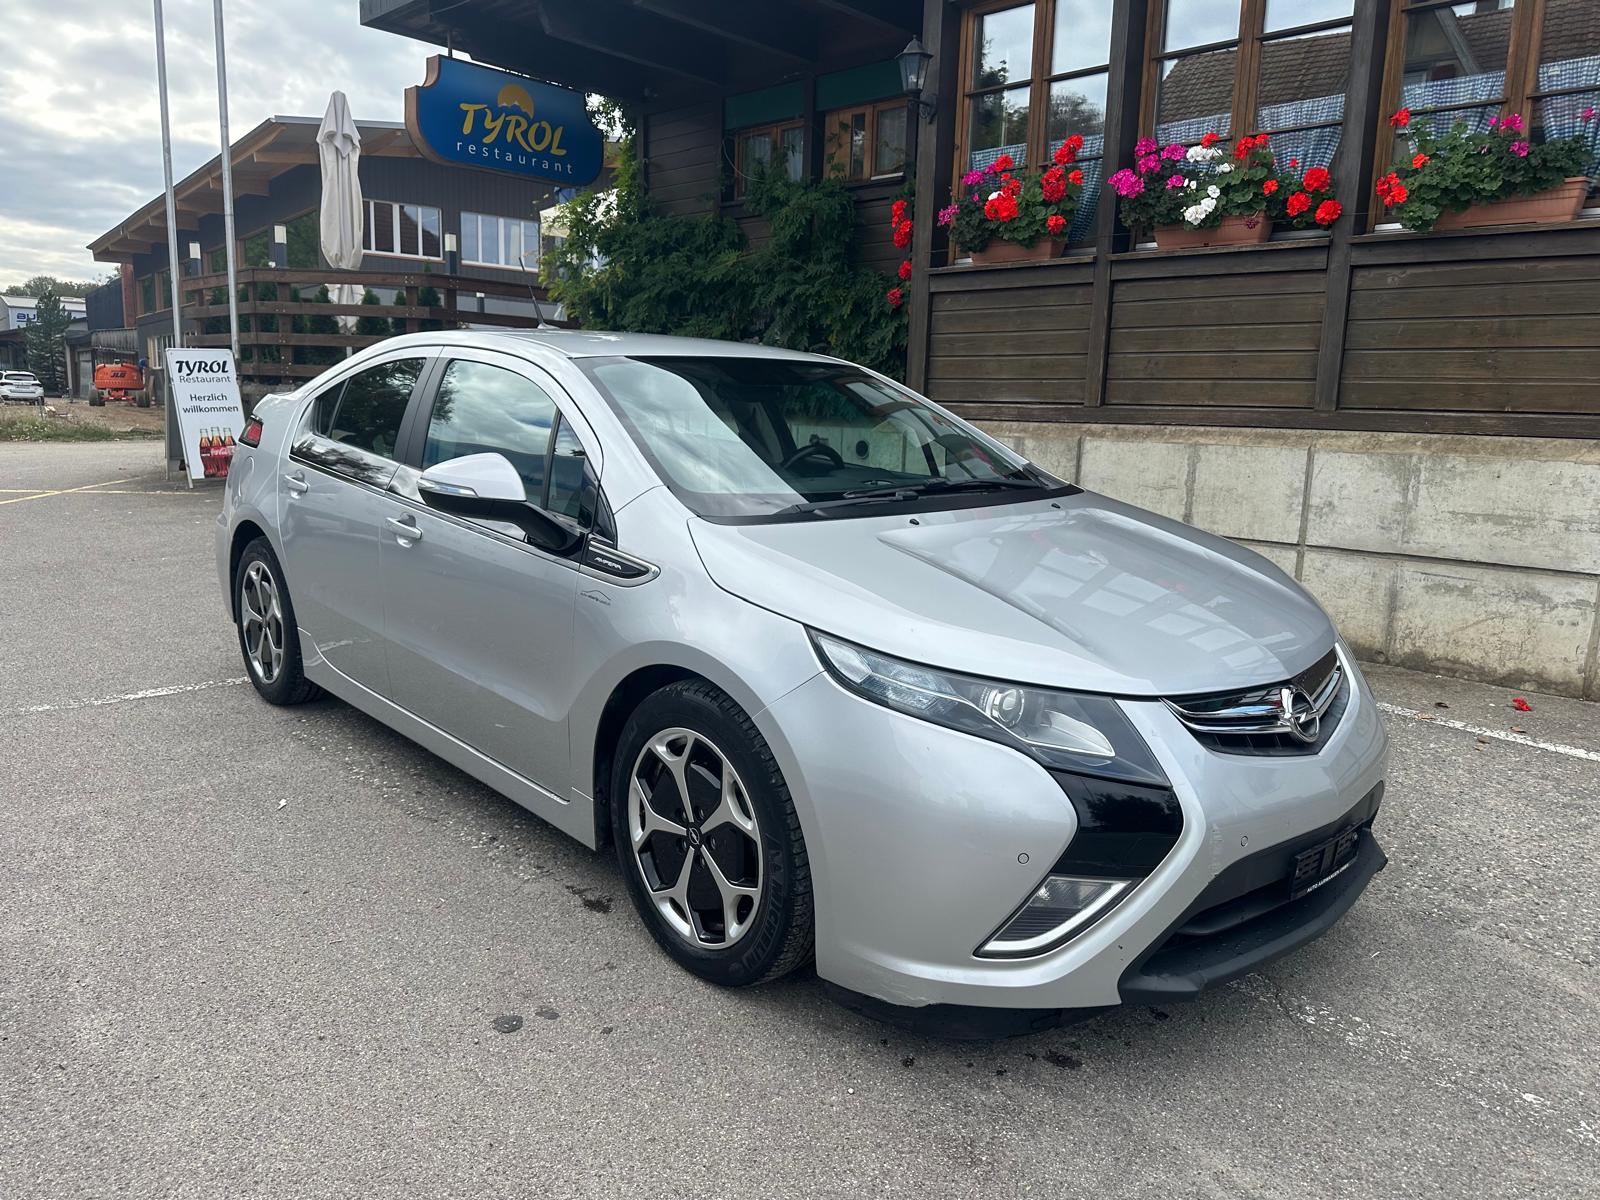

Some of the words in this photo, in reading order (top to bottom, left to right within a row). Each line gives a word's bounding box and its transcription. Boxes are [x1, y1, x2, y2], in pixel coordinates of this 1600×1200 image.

[459, 103, 567, 156] TYROL
[456, 141, 573, 175] restaurant
[176, 360, 229, 376] TYROL
[179, 375, 231, 383] Restaurant
[190, 393, 228, 402] Herzlich
[182, 404, 239, 413] willkommen
